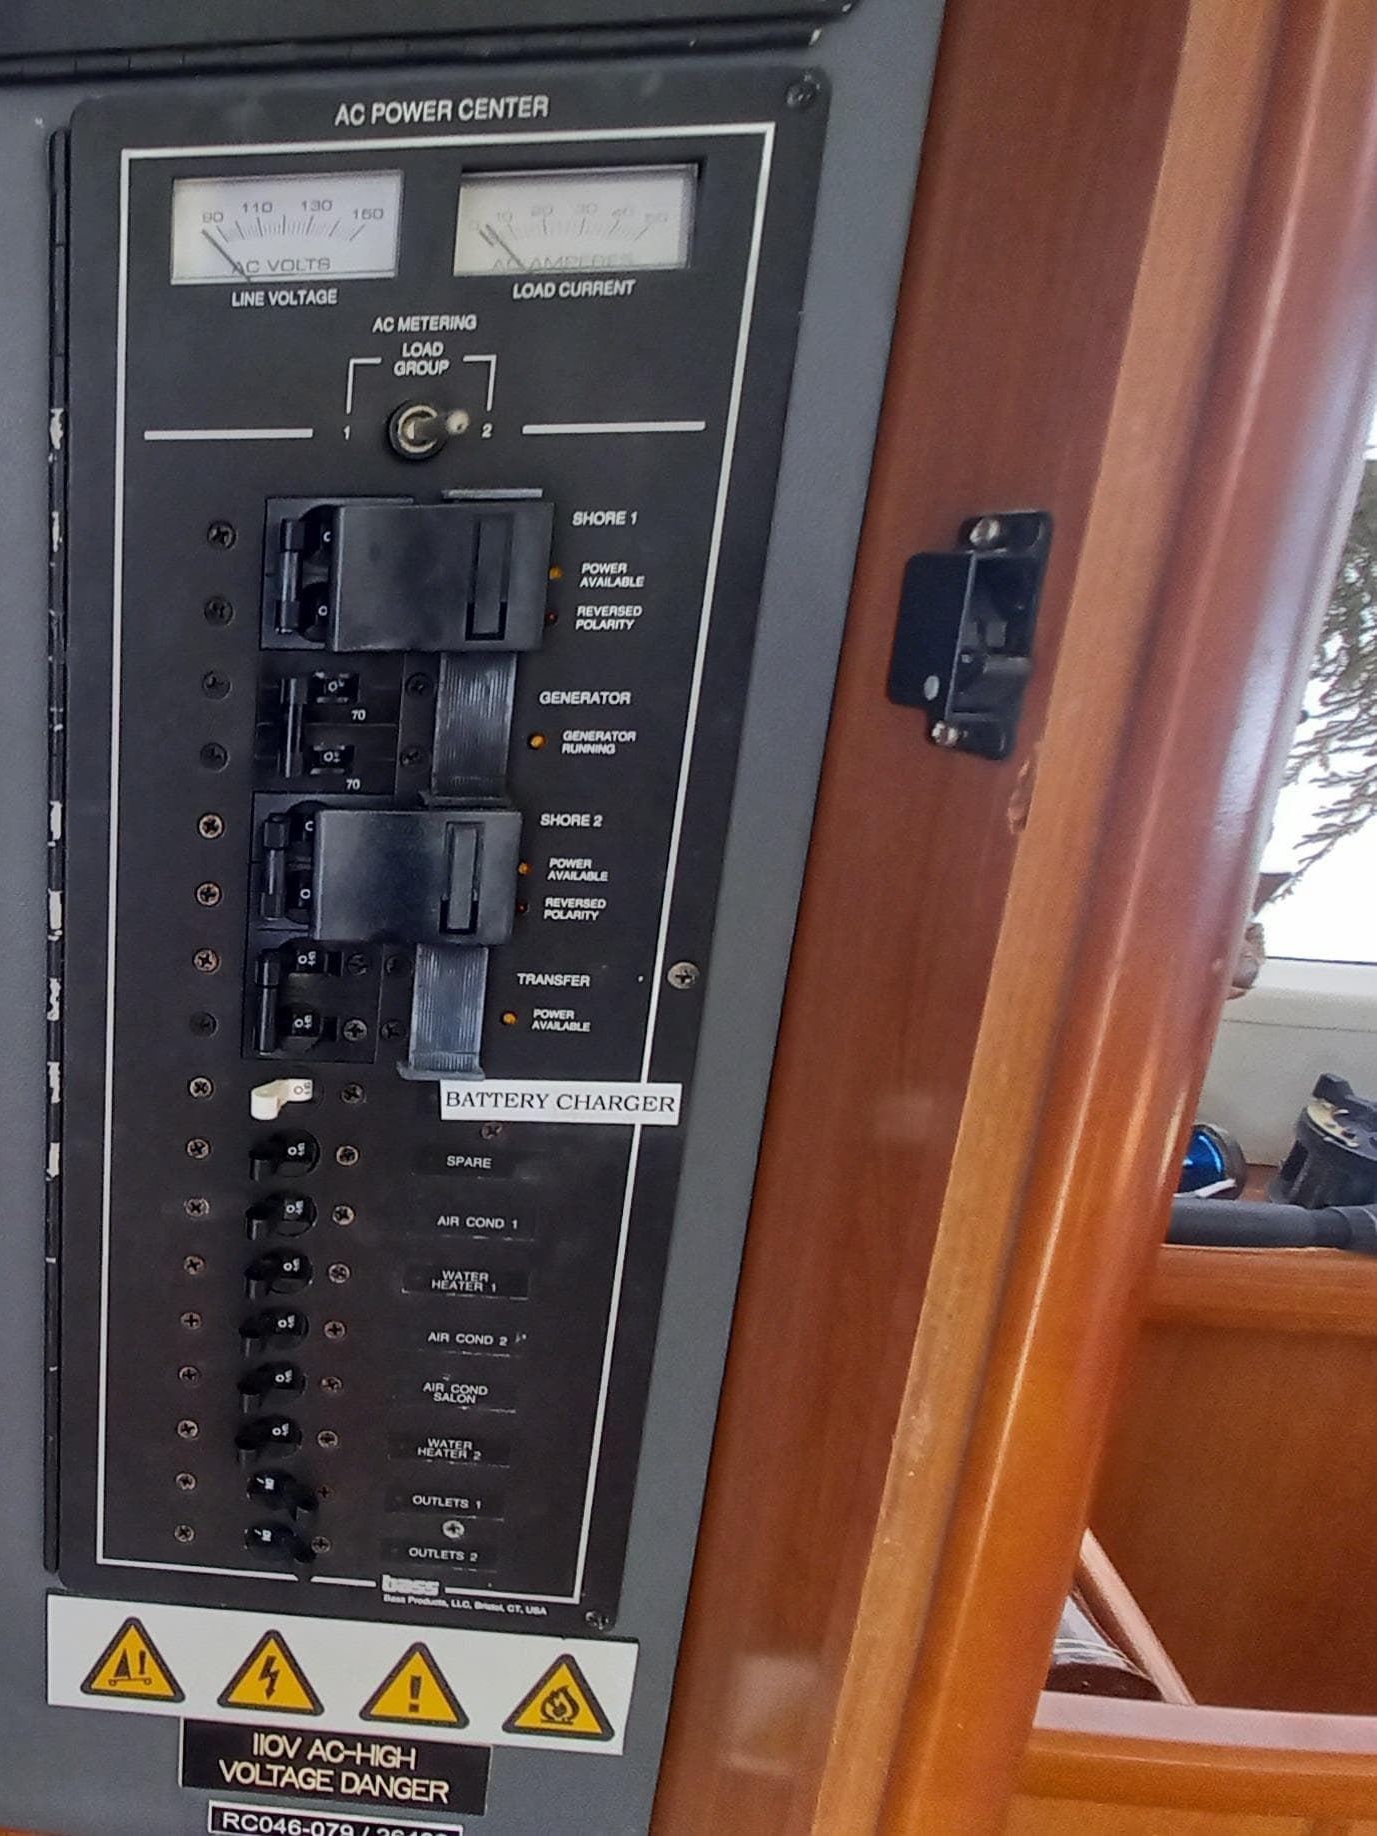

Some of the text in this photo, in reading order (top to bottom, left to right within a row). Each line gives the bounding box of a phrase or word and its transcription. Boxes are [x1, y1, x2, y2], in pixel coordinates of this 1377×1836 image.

[334, 95, 550, 126] AC POWER CENTER
[512, 279, 636, 299] LOAD CURRENT
[231, 289, 338, 307] LINE VOLTAGE
[373, 315, 478, 332] AC METERING
[402, 342, 444, 357] LOAD
[394, 360, 449, 376] GROUP
[343, 425, 350, 440] 1
[481, 423, 492, 438] 2
[572, 511, 638, 526] SHORE 1
[581, 563, 627, 574] POWER
[579, 576, 645, 588] AVAILABLE
[577, 605, 642, 617] REVERSED
[575, 619, 635, 631] POLARITY
[539, 691, 631, 705] GENERATOR
[351, 709, 366, 721] 70
[562, 731, 636, 742] GENERATOR
[561, 744, 616, 755] RUNNING
[346, 778, 361, 790] 70
[540, 814, 603, 827] SHORE 2
[549, 858, 592, 870] POWER
[547, 871, 609, 882] AVAILABLE
[545, 897, 607, 910] REVERSED
[543, 909, 599, 921] POLARITY
[517, 973, 591, 987] TRANSFER
[533, 1008, 575, 1020] POWER
[531, 1020, 591, 1032] AVAILABLE
[446, 1091, 675, 1113] BATTERY CHARGER
[446, 1155, 492, 1168] SPARE
[437, 1216, 518, 1229] AIR COND 1
[442, 1270, 489, 1282] WATER
[431, 1279, 496, 1292] HEATER 1
[428, 1332, 508, 1347] AIR COND 2
[423, 1382, 488, 1396] AIR COND
[433, 1392, 476, 1404] SALON
[427, 1438, 473, 1450] WATER
[417, 1447, 481, 1461] HEATER 2
[412, 1495, 481, 1509] OUTLETS 1
[409, 1547, 478, 1562] OUTLETS 2
[525, 1606, 548, 1616] USA
[307, 1739, 416, 1770] AC-HIGH
[218, 1759, 450, 1804] VOLTAGE DANGER
[223, 1811, 355, 1836] RC046-079
